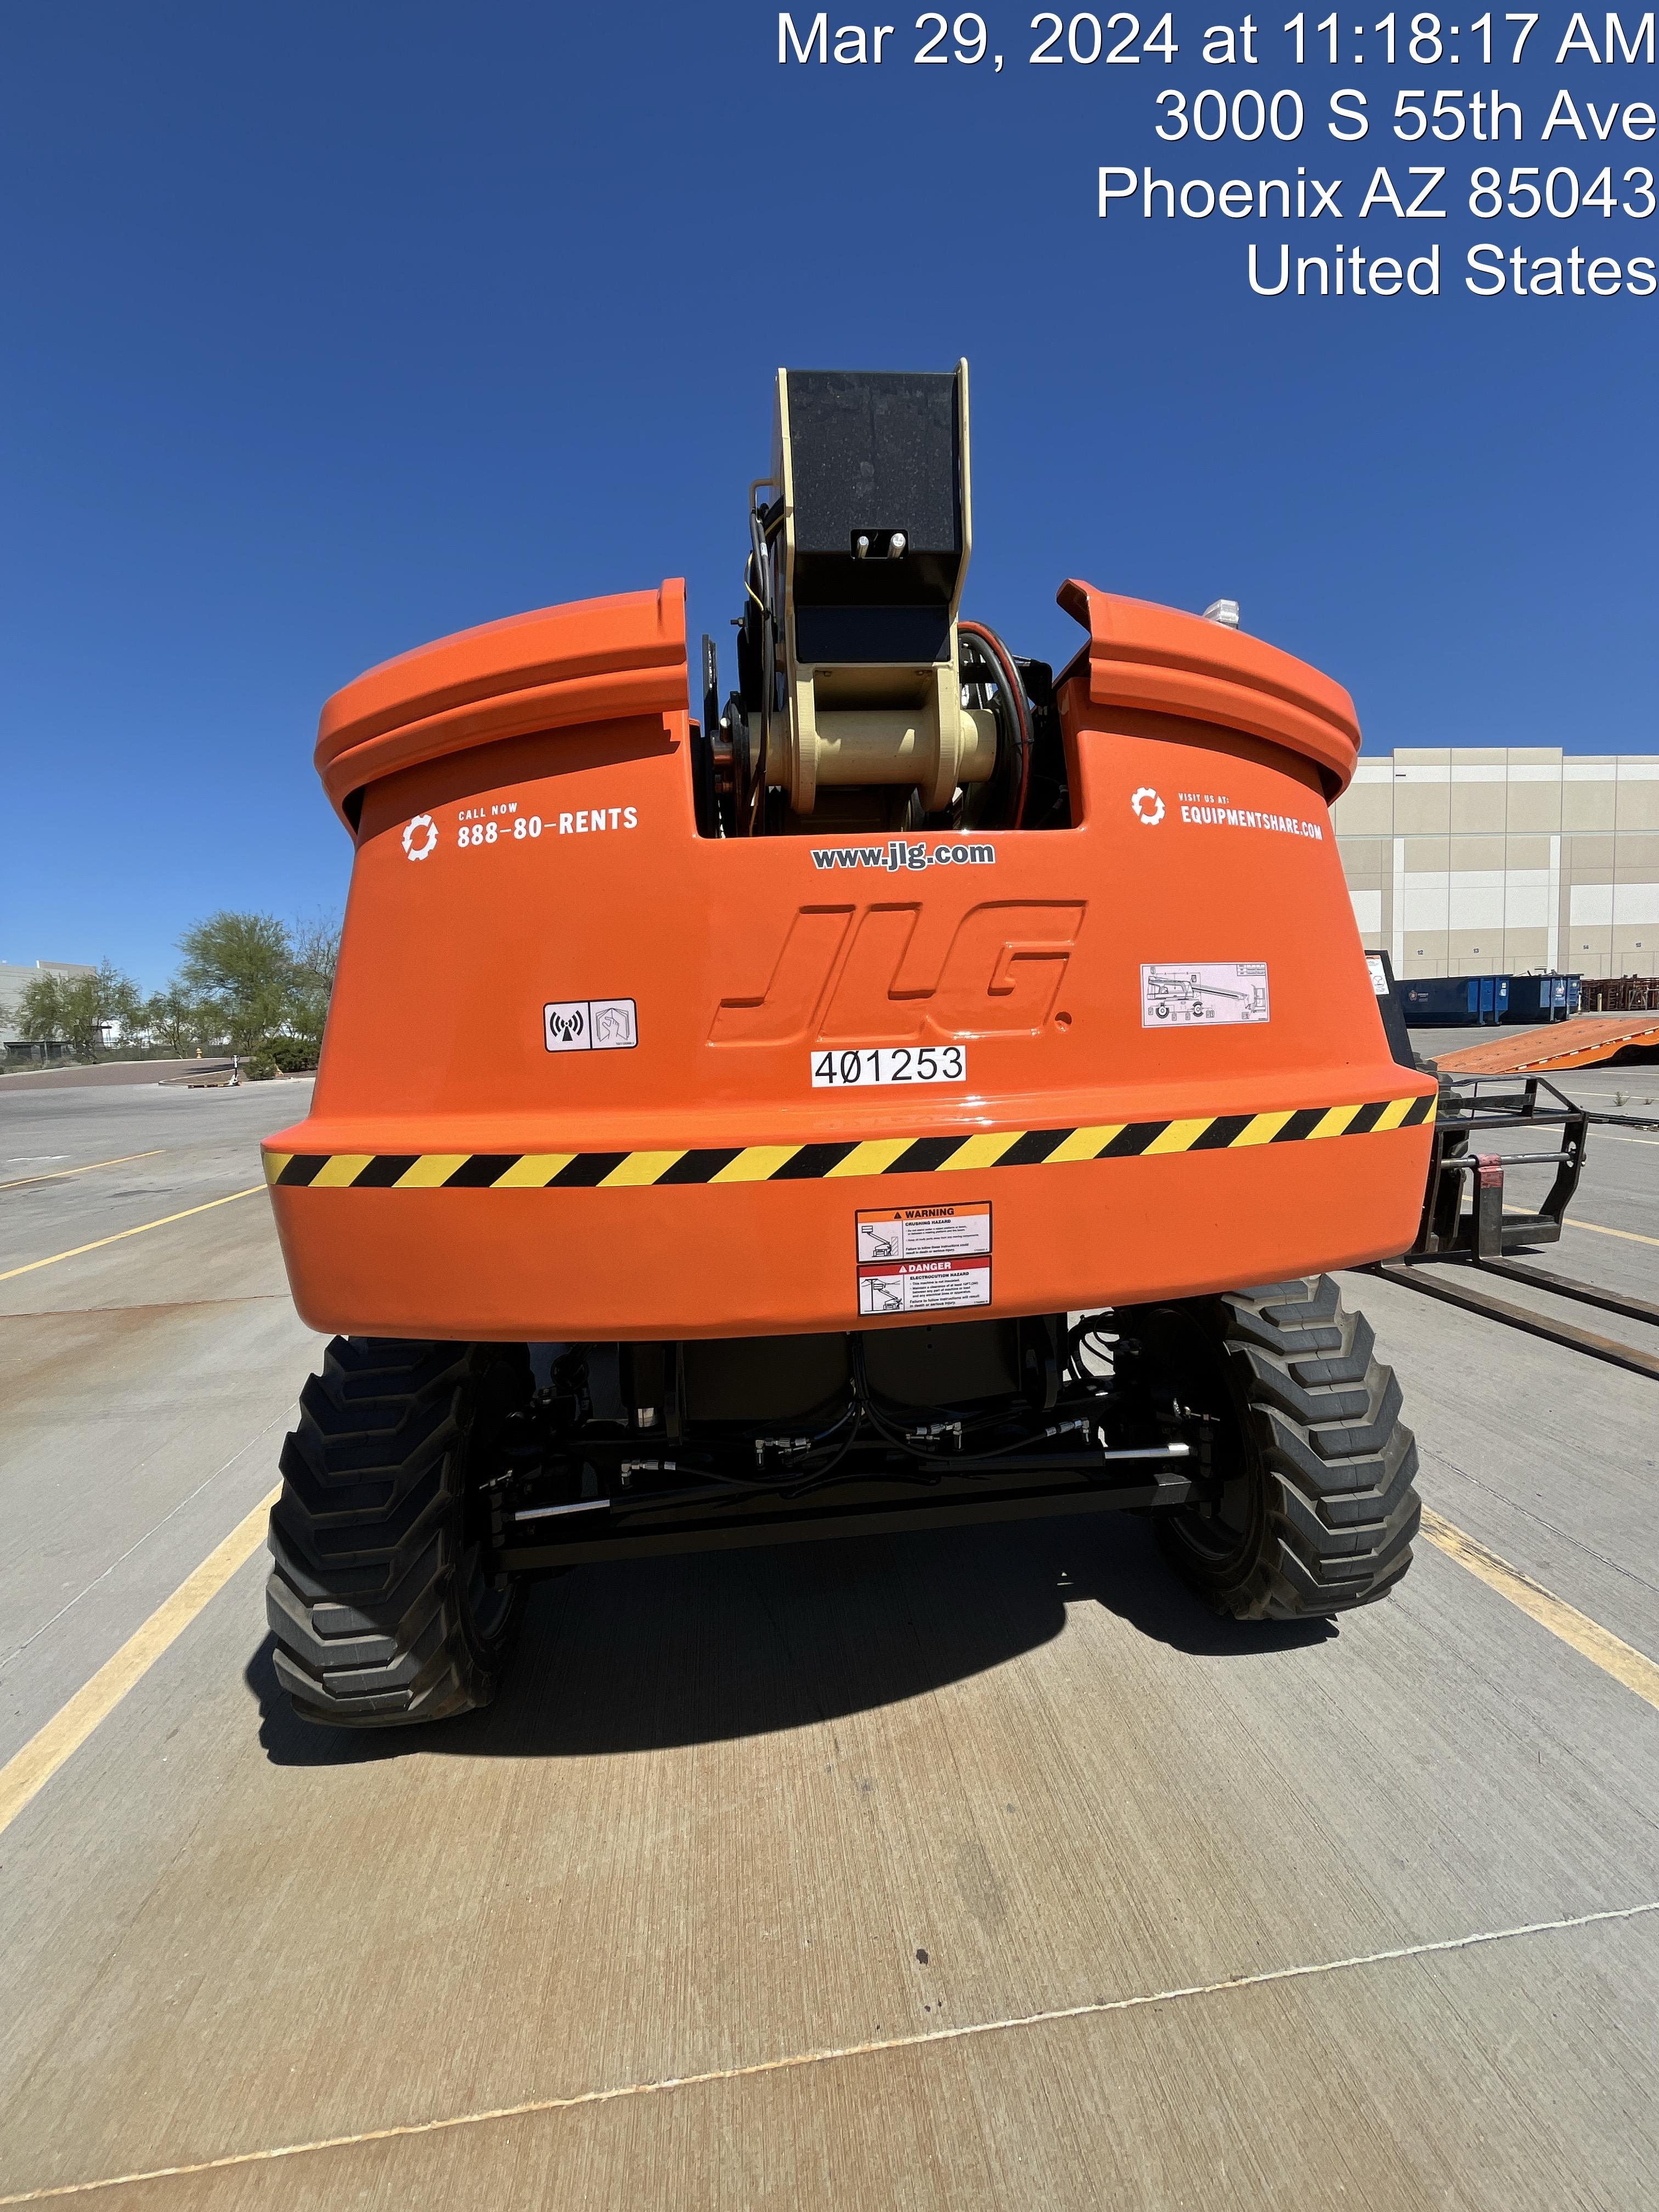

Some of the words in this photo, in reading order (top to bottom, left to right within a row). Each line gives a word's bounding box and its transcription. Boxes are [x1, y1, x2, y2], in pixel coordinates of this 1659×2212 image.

[1178, 793, 1200, 802] VISIT
[1204, 794, 1214, 803] US
[1218, 795, 1229, 804] AT:
[458, 807, 486, 821] CALL
[492, 802, 518, 815] NOW
[1181, 805, 1323, 840] EQUIPMENTSHARE.COM
[457, 806, 638, 848] 888-80-RENTS
[811, 841, 996, 872] www.jlg.com
[706, 900, 1088, 1048] JLG
[905, 1208, 954, 1218] WARNING
[909, 1262, 951, 1272] DANGER
